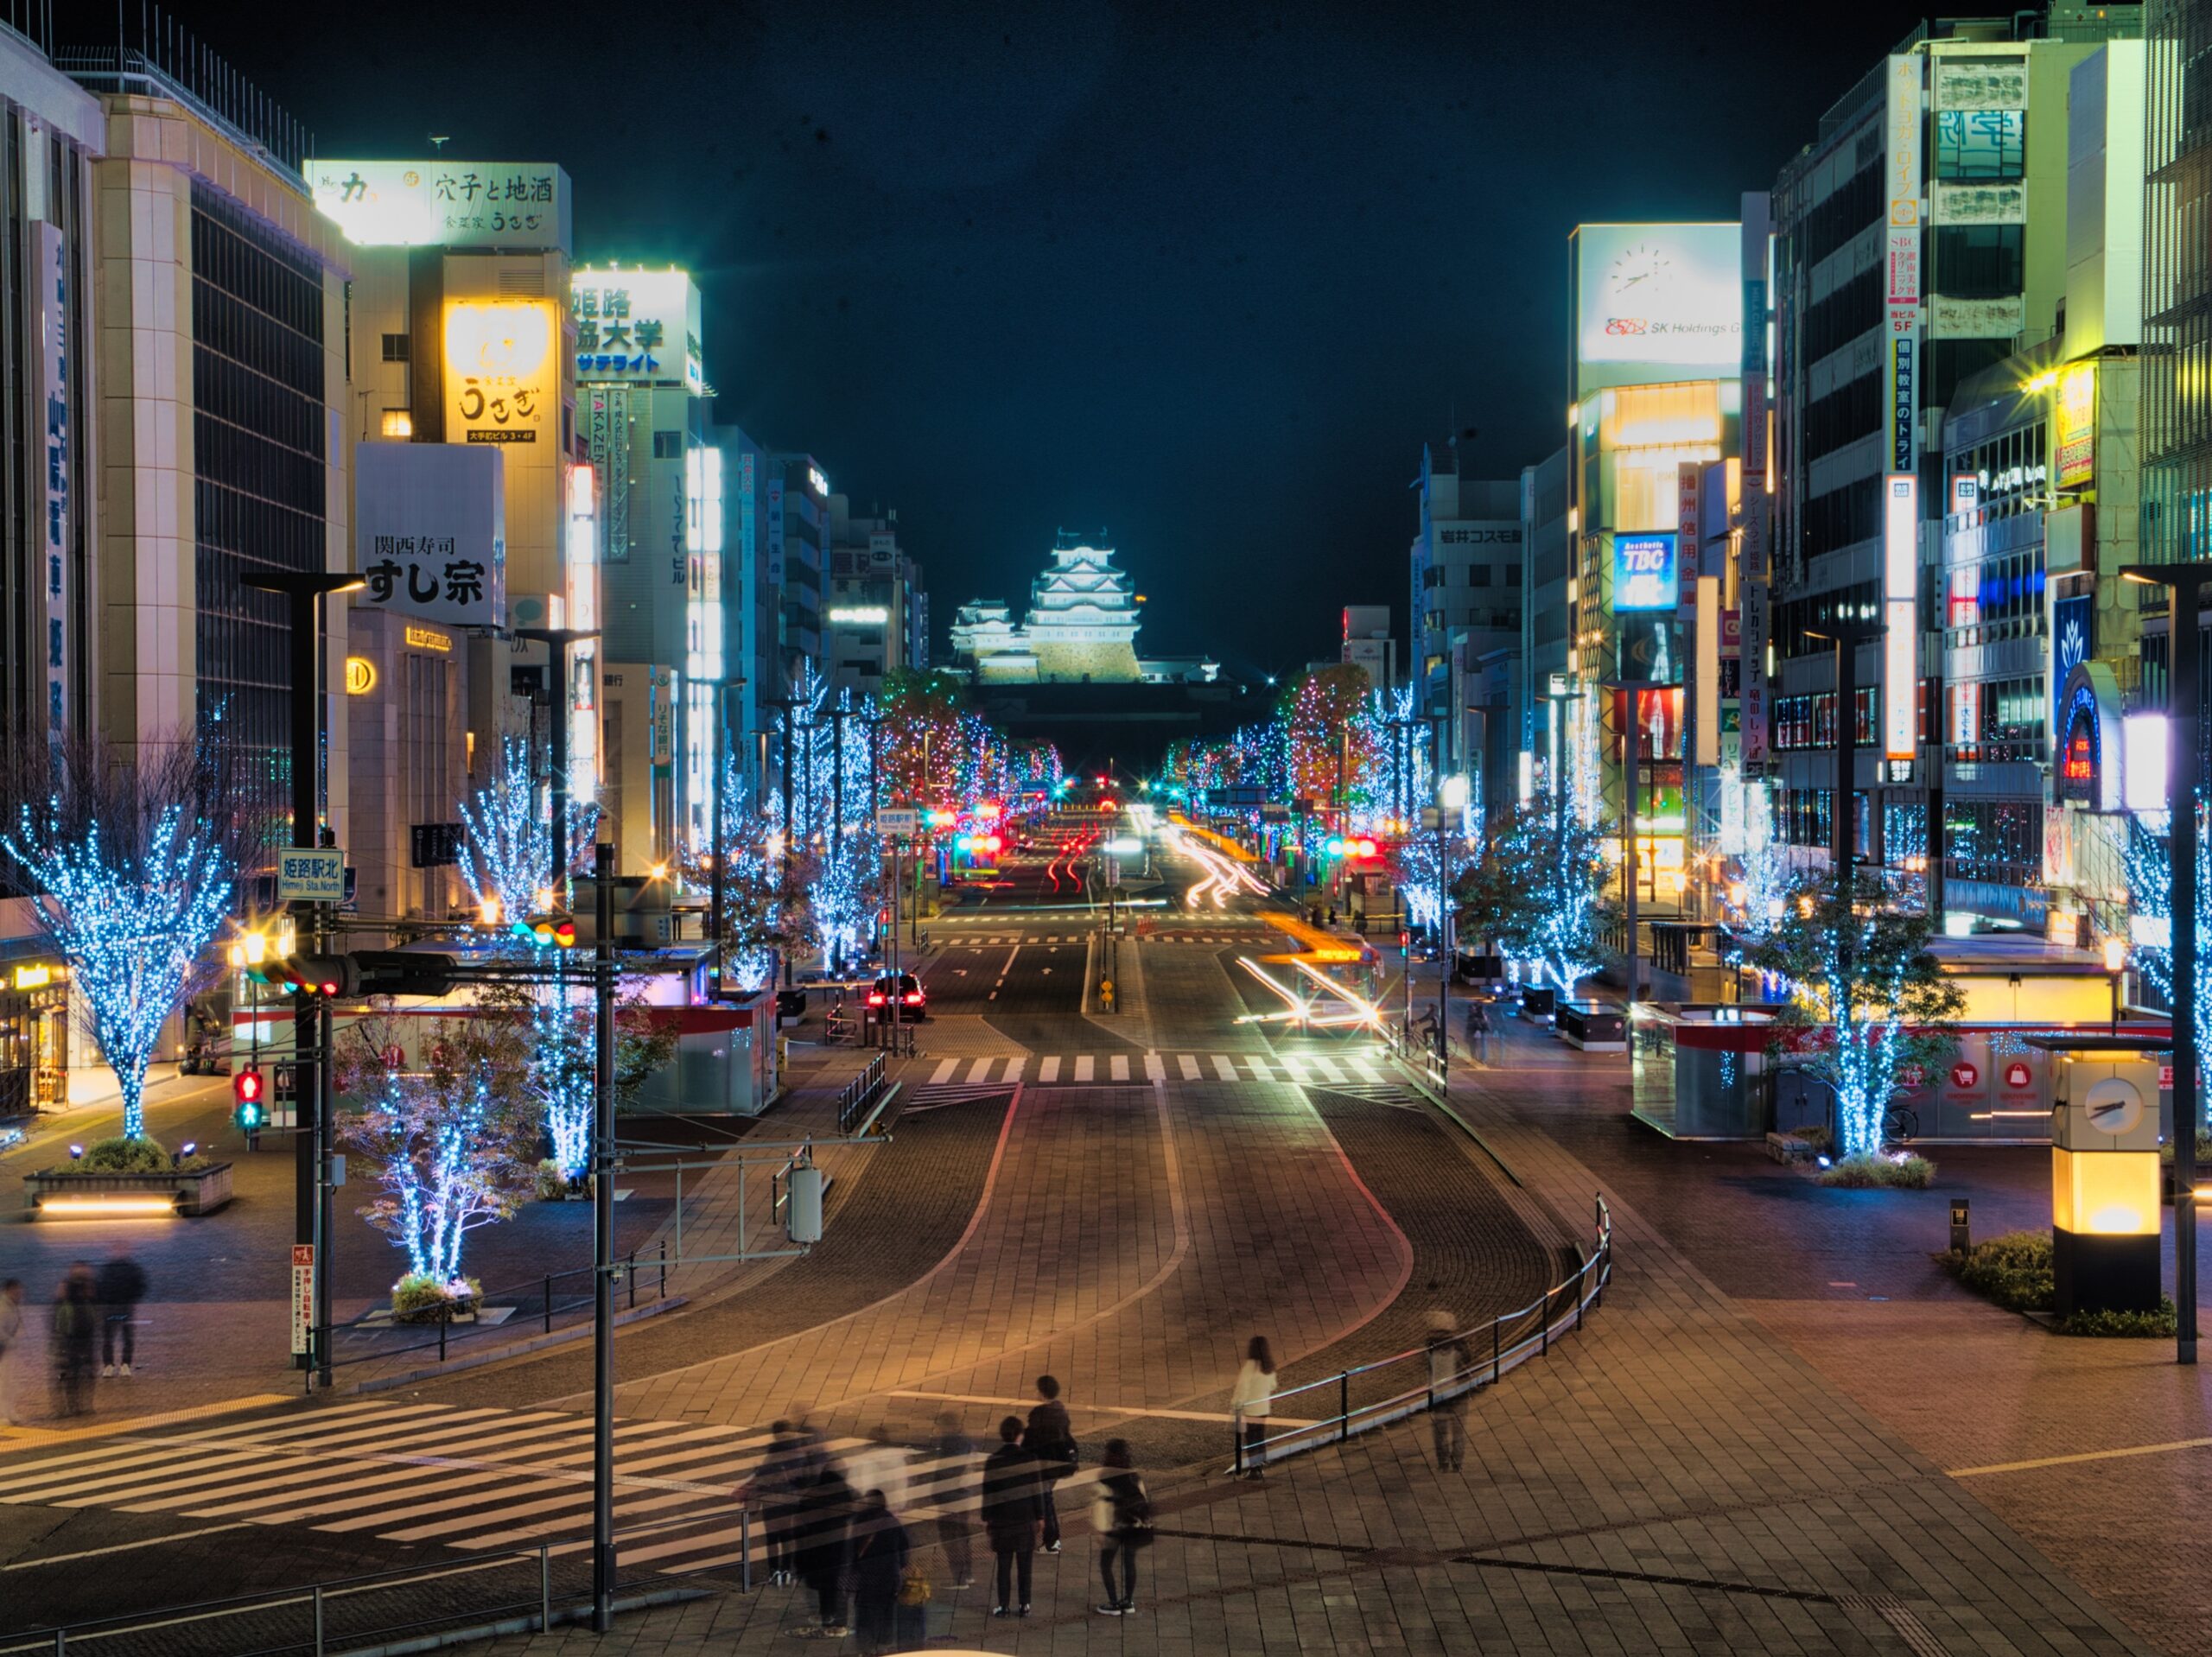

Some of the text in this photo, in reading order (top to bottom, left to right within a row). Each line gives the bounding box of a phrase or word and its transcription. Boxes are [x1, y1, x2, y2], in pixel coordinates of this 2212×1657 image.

[435, 174, 553, 203] 穴子と地酒
[491, 213, 543, 232] うさぎ
[1651, 322, 1669, 333] SK
[1672, 322, 1726, 336] Holdings
[1894, 321, 1912, 331] 5F
[577, 354, 659, 372] サテライト
[459, 378, 540, 425] うさぎ
[1897, 340, 1910, 469] 個別教室のトライ
[594, 392, 606, 464] TAKAZEN
[375, 536, 454, 556] 関西寿司
[1681, 475, 1696, 606] 播州信用金庫
[1624, 549, 1664, 571] TBC
[365, 560, 485, 605] すし宗
[658, 704, 667, 755] りそな銀行
[283, 858, 338, 879] 姫路駅北
[282, 881, 303, 892] Himeji
